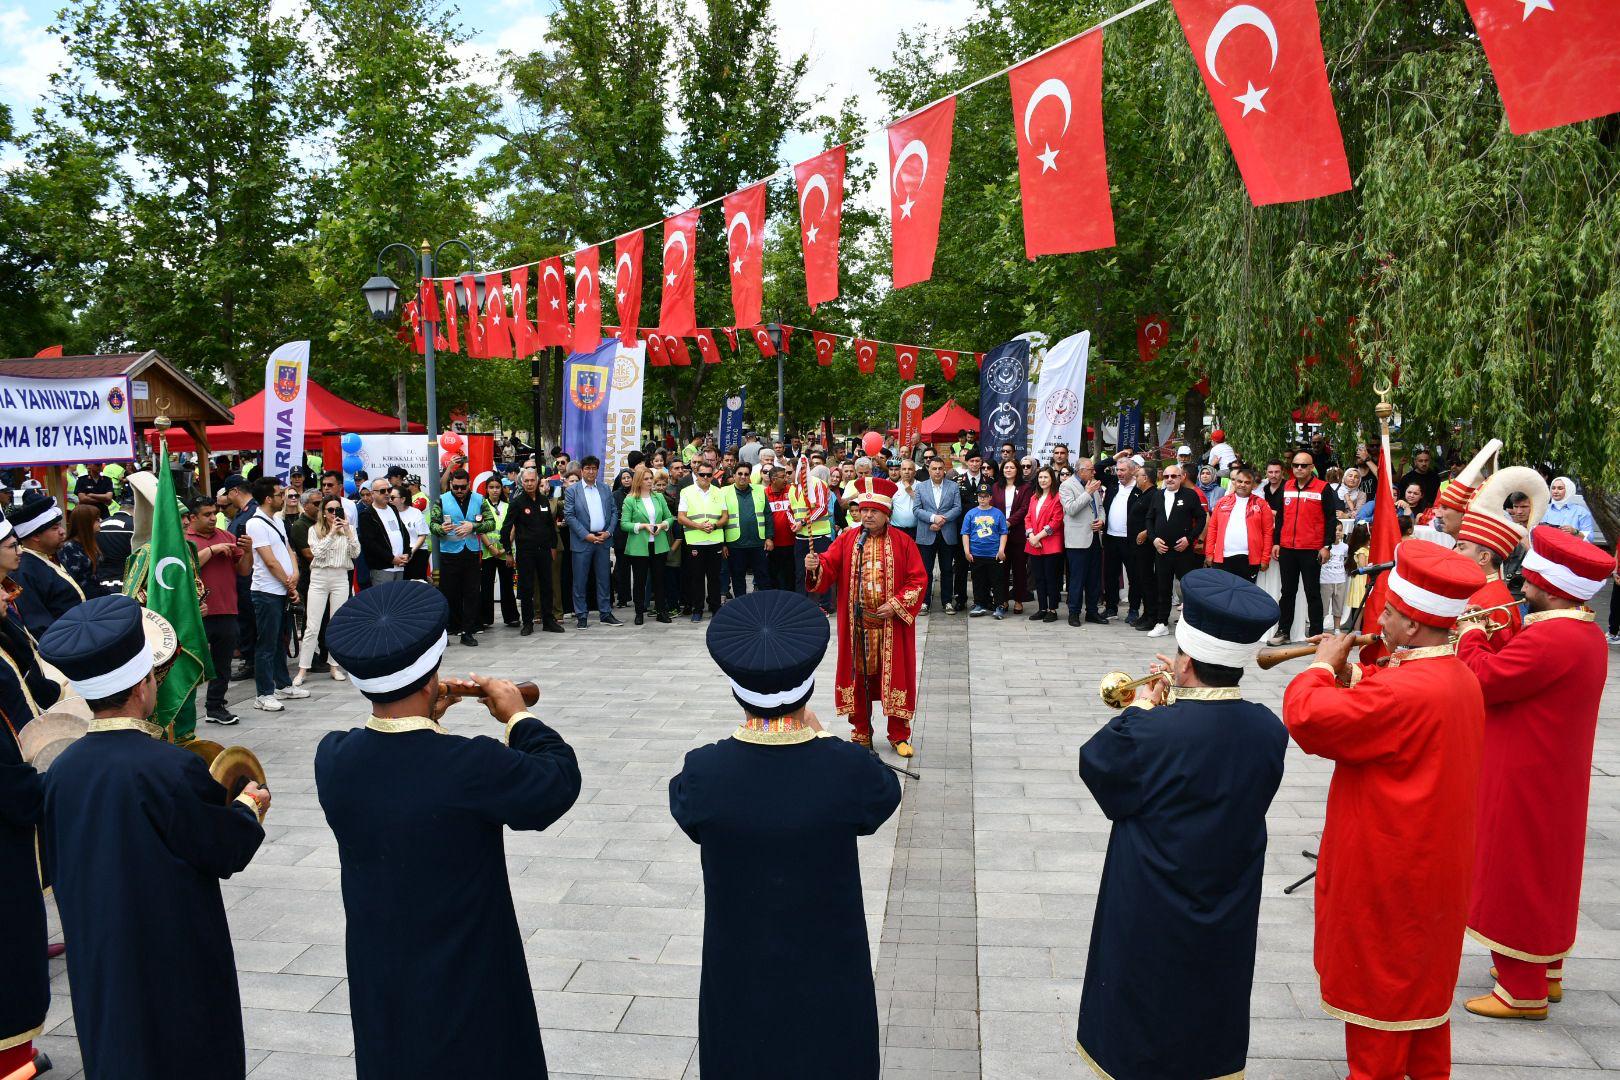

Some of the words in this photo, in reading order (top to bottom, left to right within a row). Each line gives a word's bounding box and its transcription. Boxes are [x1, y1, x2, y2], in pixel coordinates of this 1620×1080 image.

[0, 388, 17, 409] A
[16, 388, 100, 410] YANINIZDA
[0, 426, 30, 448] MA
[35, 426, 60, 448] 187
[63, 425, 128, 449] YAŞINDA
